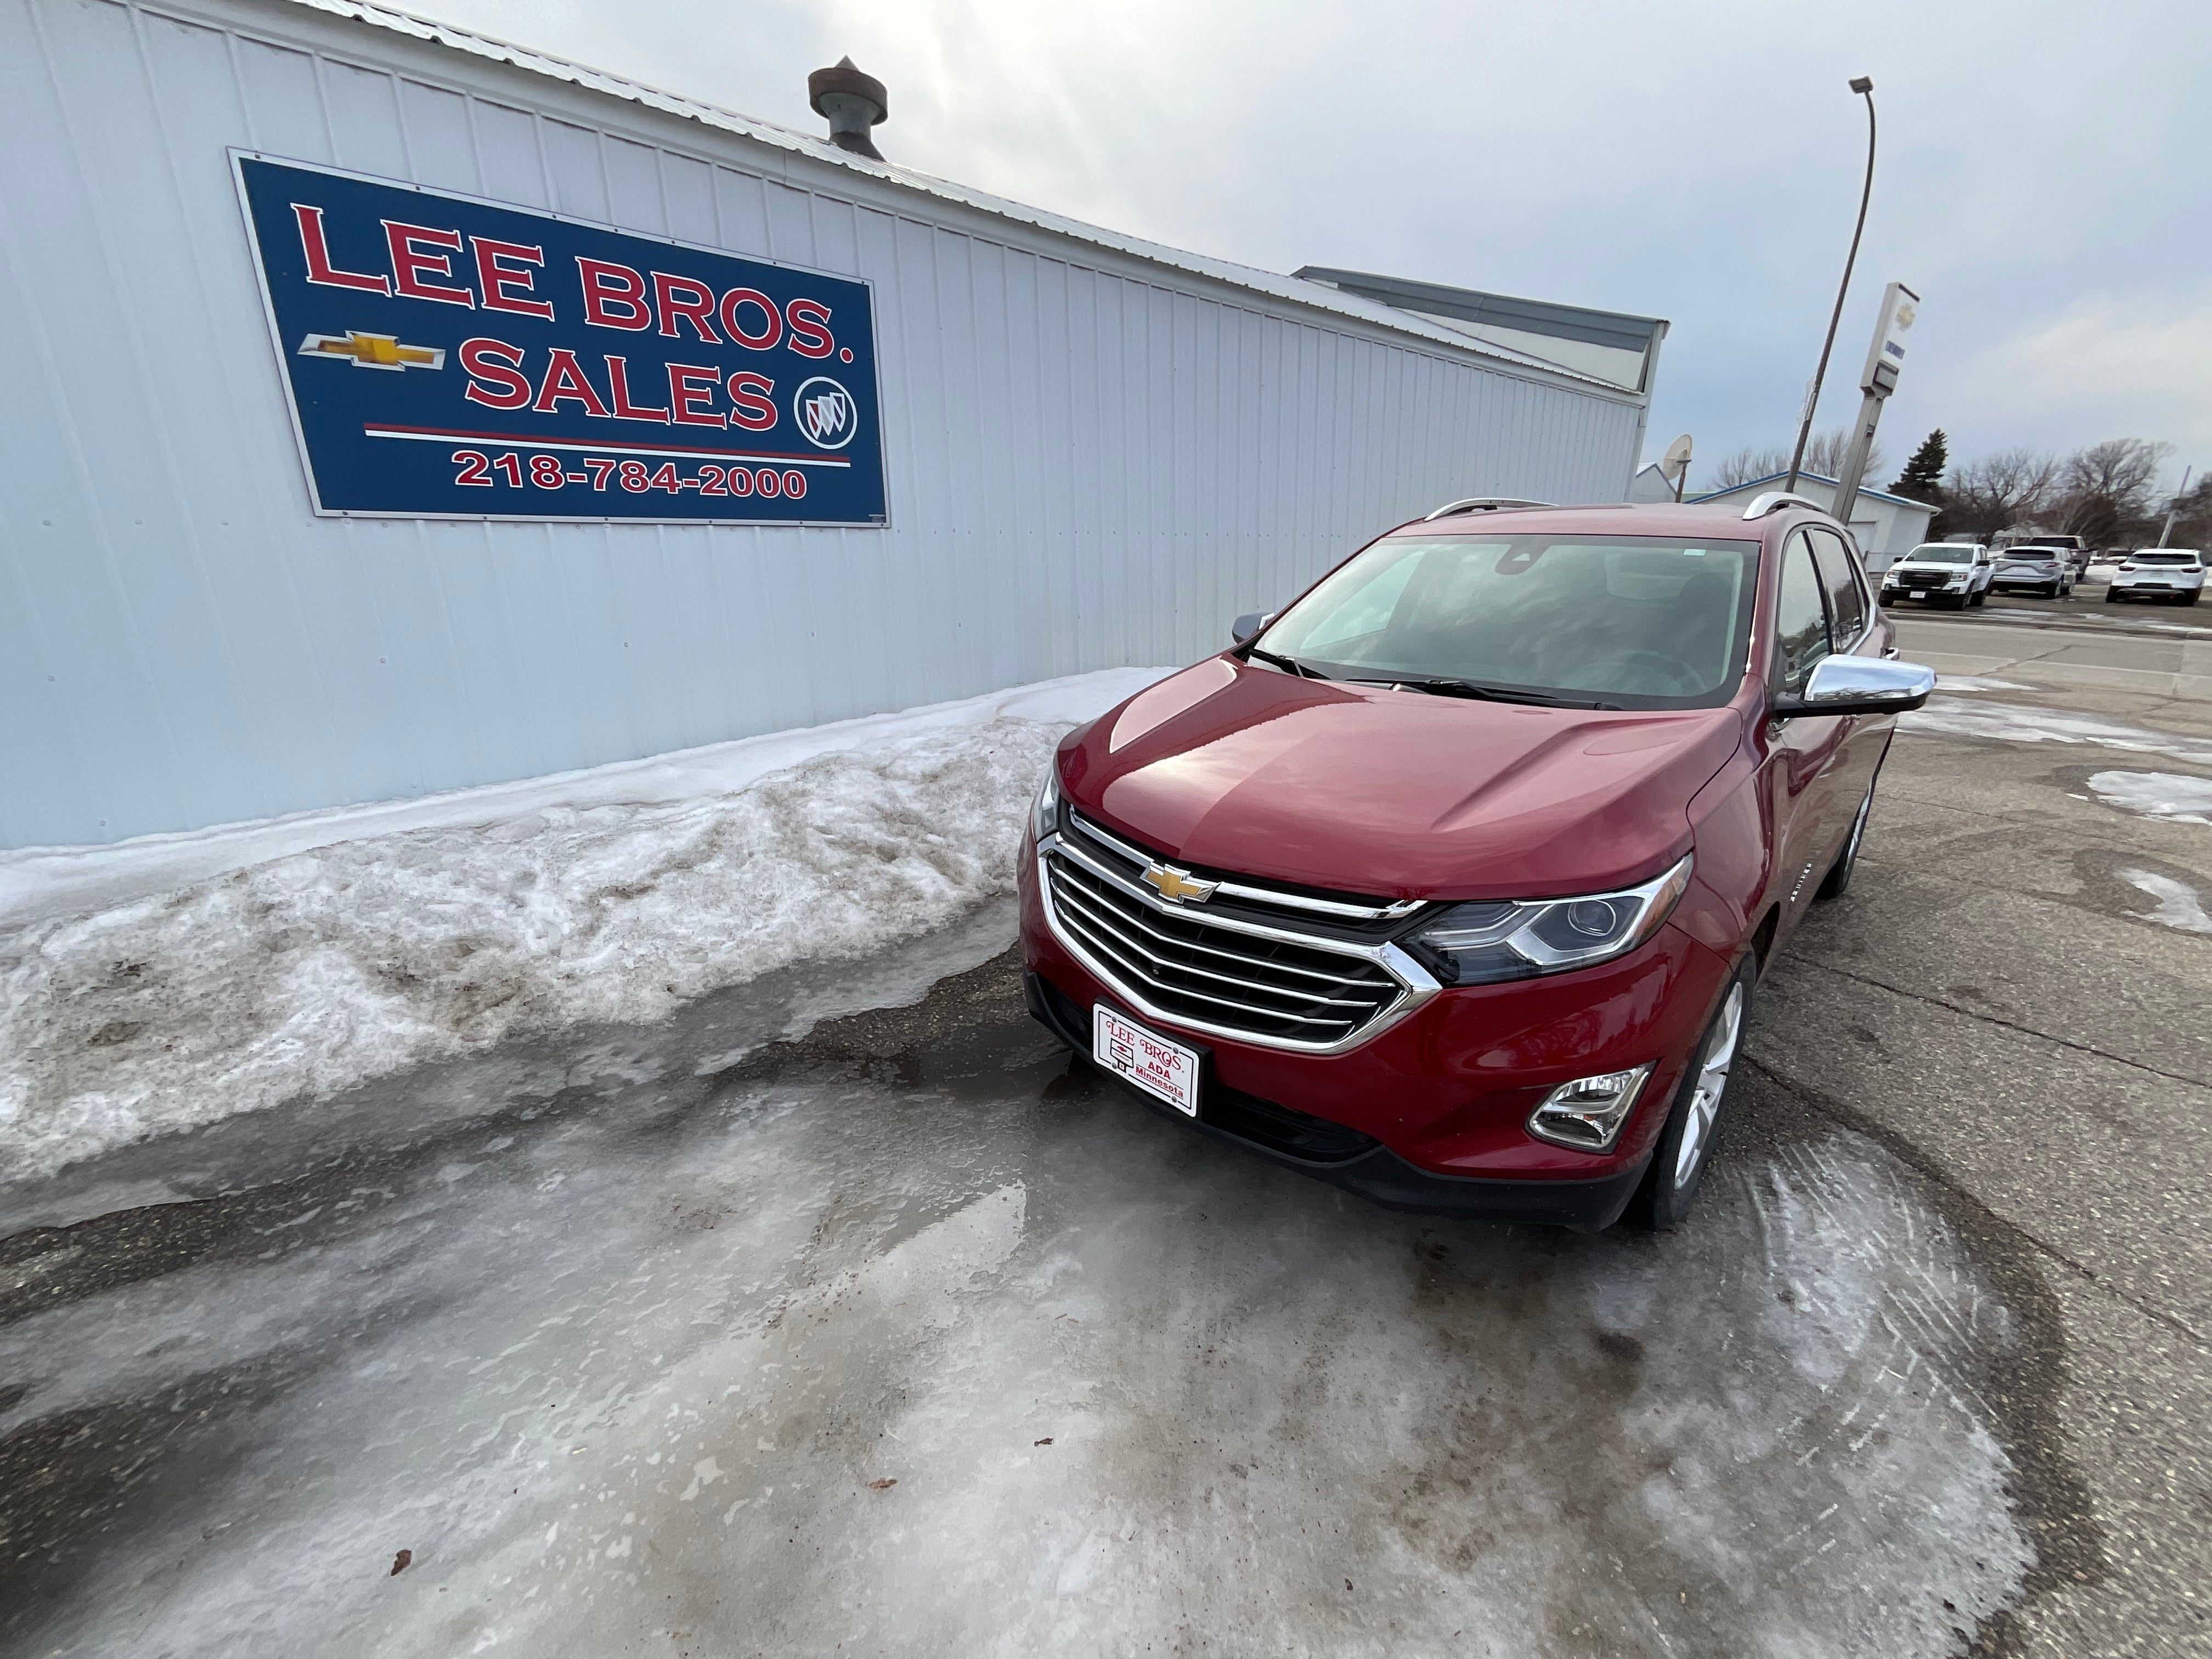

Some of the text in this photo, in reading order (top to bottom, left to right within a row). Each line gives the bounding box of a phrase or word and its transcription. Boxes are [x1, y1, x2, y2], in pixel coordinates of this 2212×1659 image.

[289, 202, 855, 364] LEE BROS.
[458, 337, 778, 432] SALES
[452, 450, 808, 500] 218-784-2000
[1106, 1020, 1135, 1046] LEE
[1136, 1065, 1183, 1098] Minnesota
[1148, 1061, 1171, 1080] ADA
